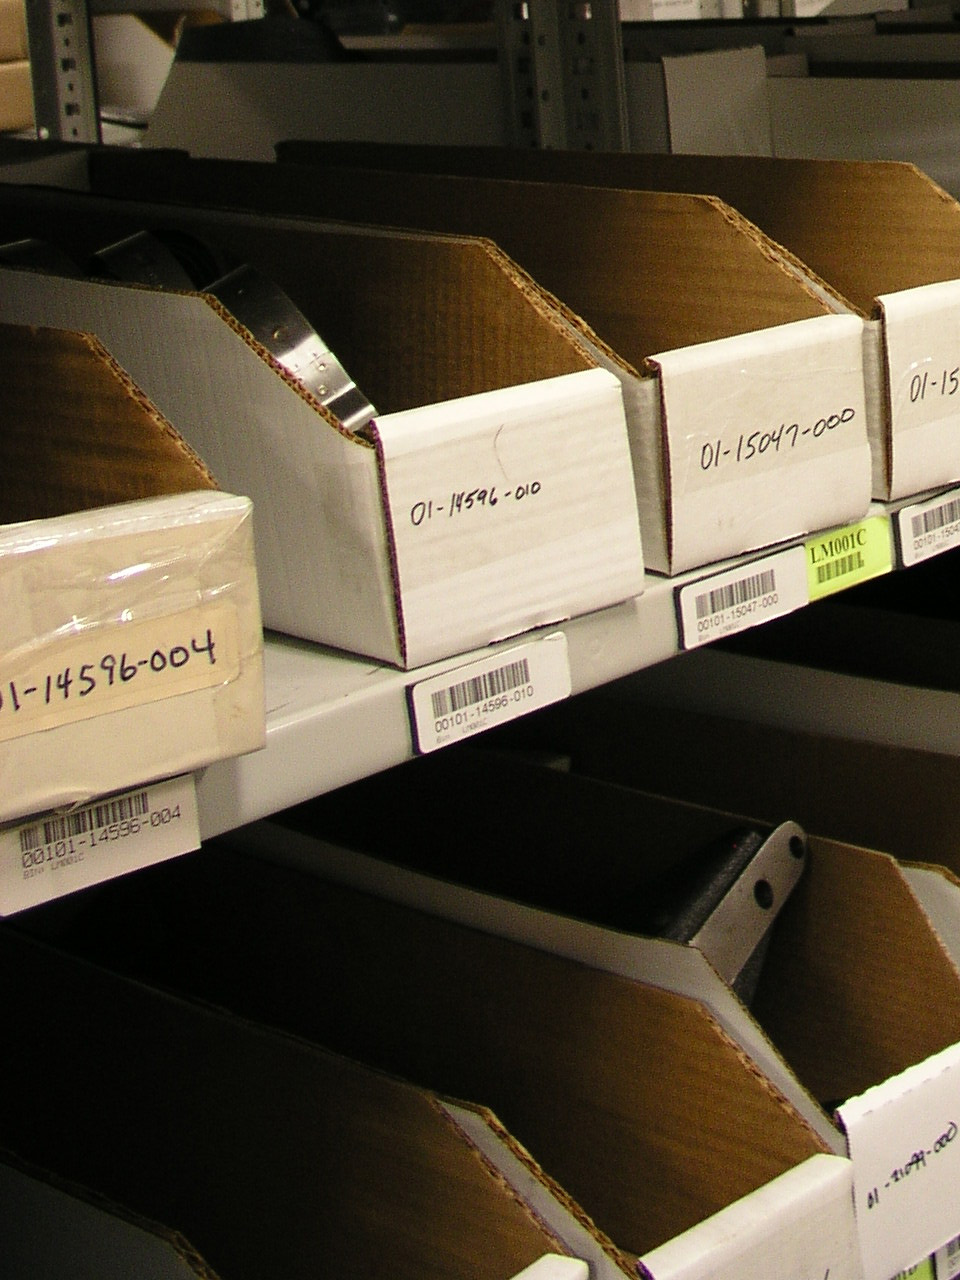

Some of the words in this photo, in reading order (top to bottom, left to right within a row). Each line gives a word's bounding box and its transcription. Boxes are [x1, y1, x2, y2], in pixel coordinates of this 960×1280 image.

[701, 408, 856, 470] 01-15047-000
[410, 481, 541, 526] 01-14596-010
[809, 528, 868, 565] LM001C
[697, 593, 779, 632] 00101-15047-000
[0, 628, 216, 712] 1-14596-004
[434, 684, 535, 734] 00101-14596-010
[22, 803, 182, 869] 00101-14596-004
